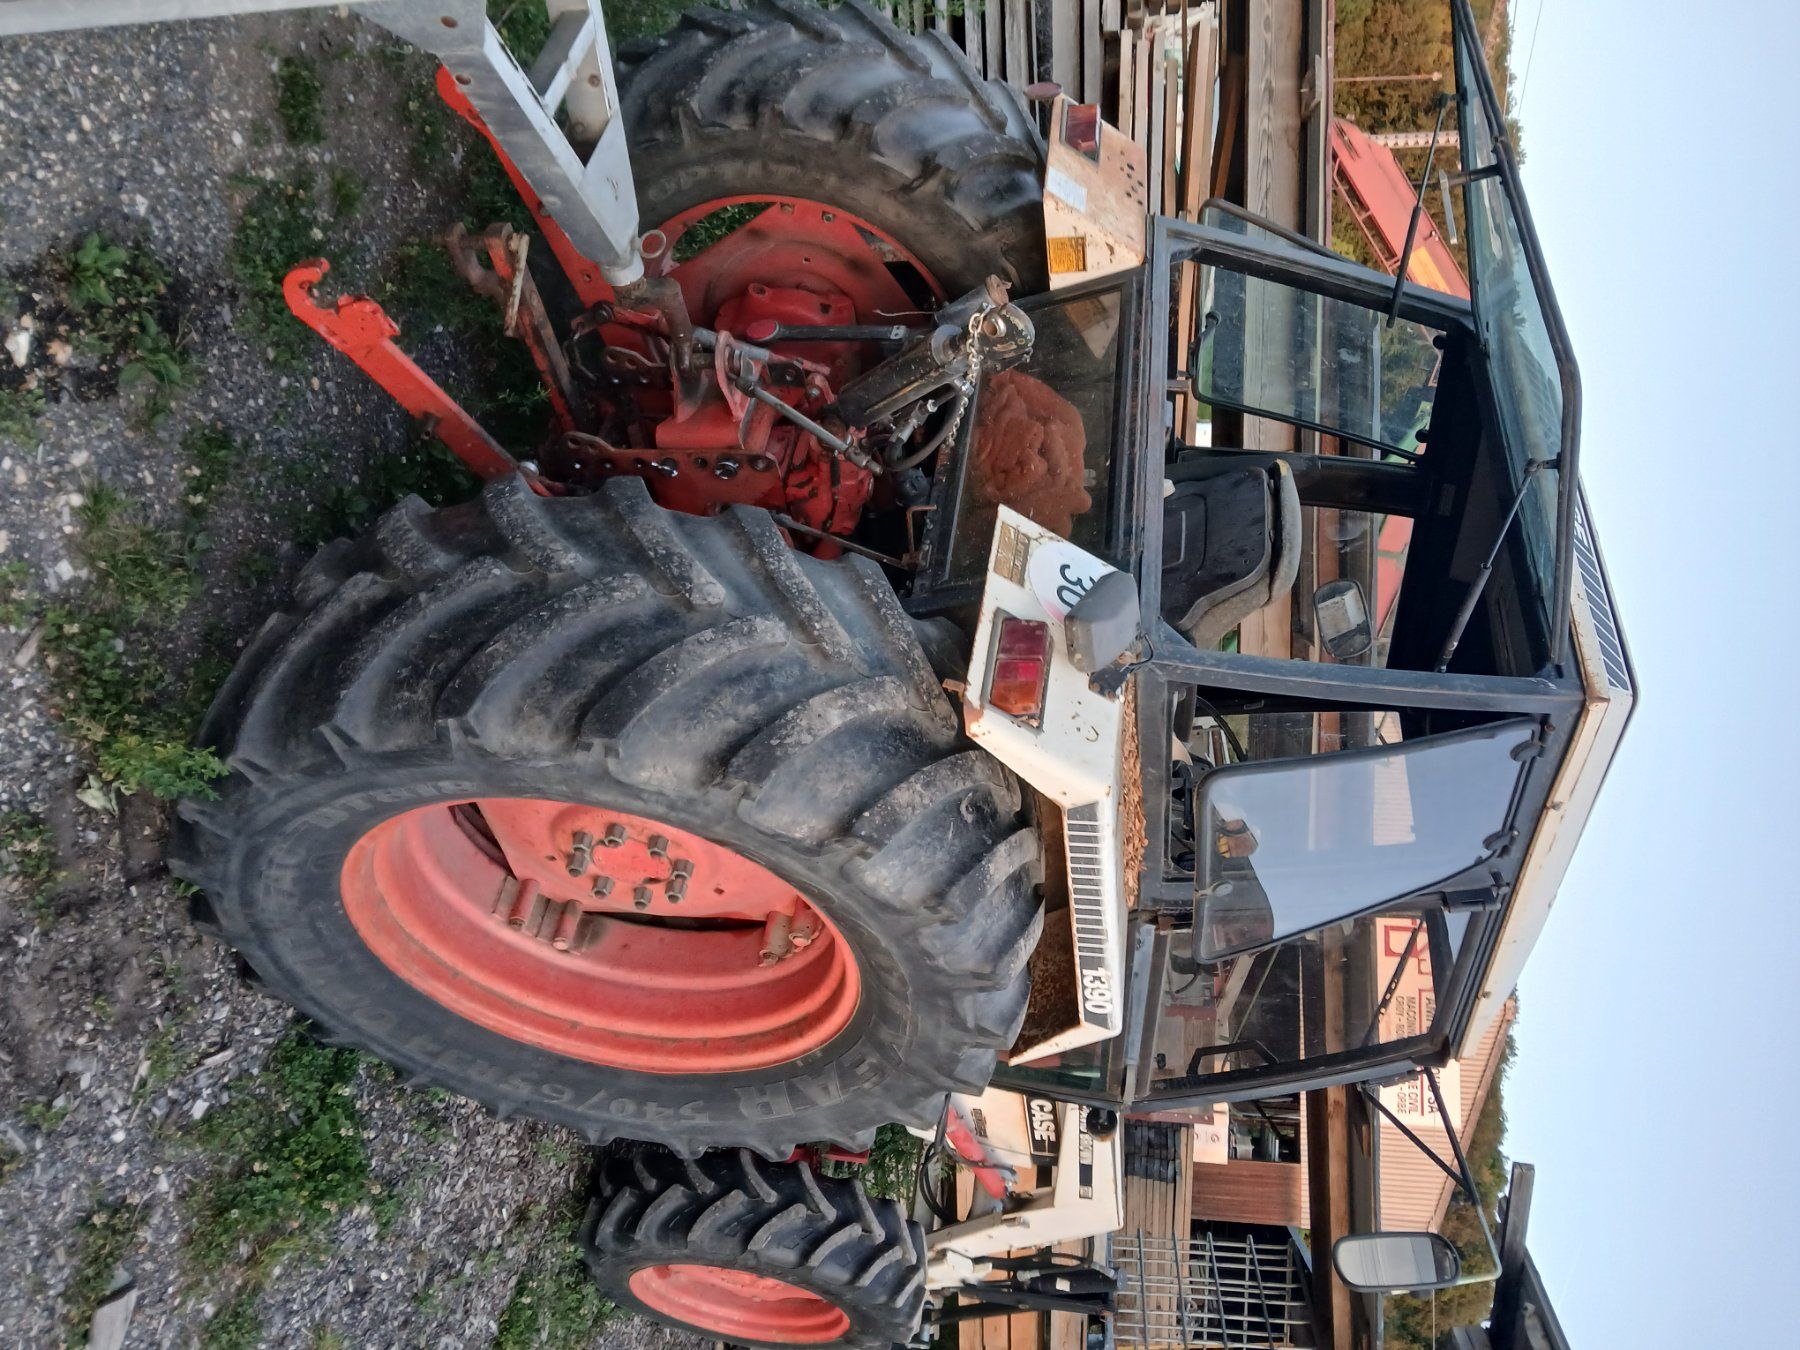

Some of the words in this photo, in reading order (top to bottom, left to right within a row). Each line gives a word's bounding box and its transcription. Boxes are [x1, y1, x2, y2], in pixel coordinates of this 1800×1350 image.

[1057, 564, 1096, 608] 30
[1082, 966, 1114, 1014] 1390
[1406, 996, 1417, 1036] MACONN
[1030, 1099, 1056, 1142] CASE
[1408, 1092, 1419, 1114] CIVIL
